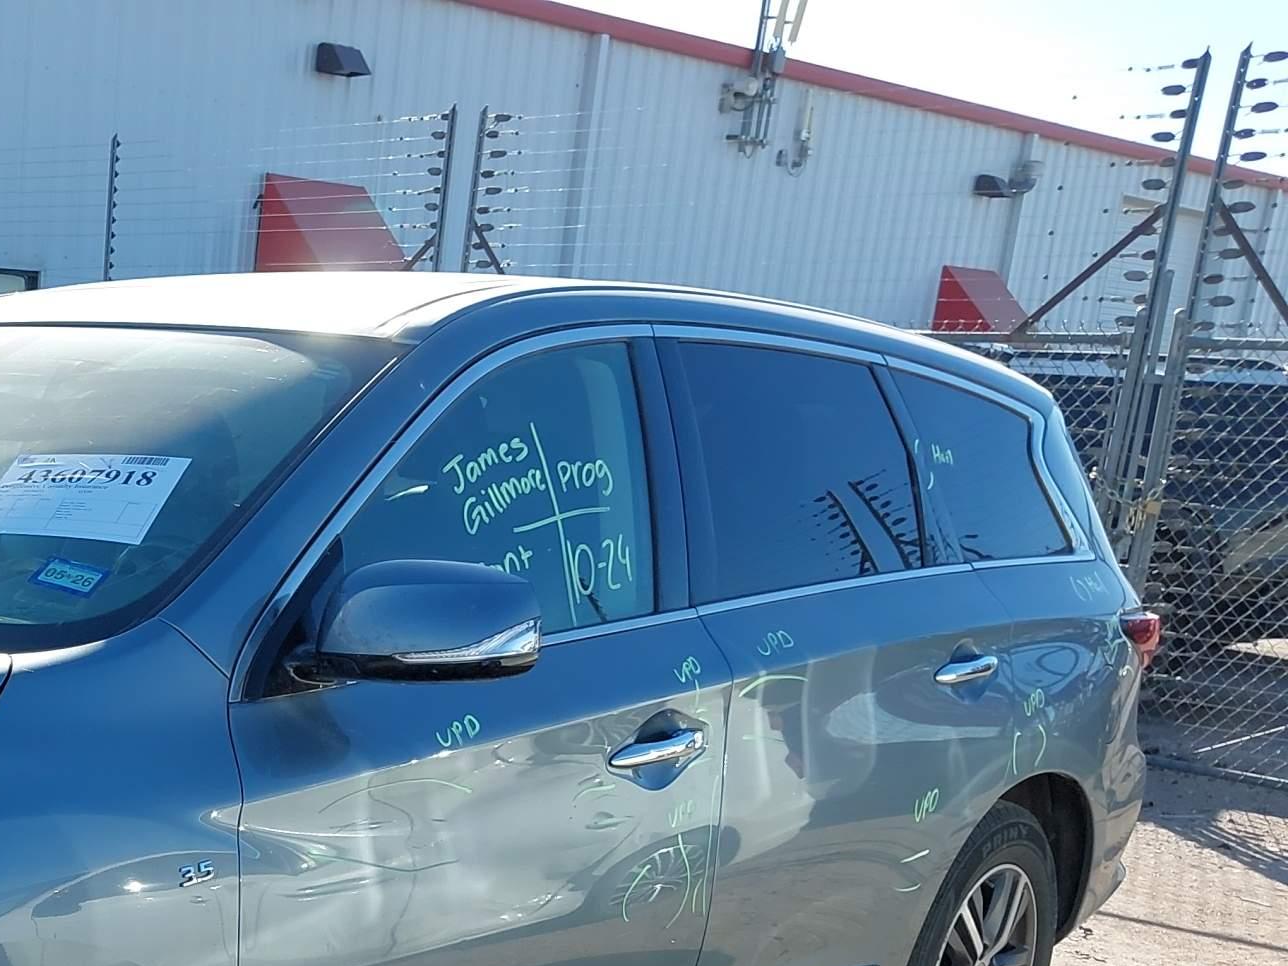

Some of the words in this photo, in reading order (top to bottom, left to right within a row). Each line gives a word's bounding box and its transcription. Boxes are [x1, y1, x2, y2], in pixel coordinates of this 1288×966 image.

[16, 468, 158, 487] 43607918
[442, 437, 529, 494] James
[463, 468, 547, 535] Gillmore
[44, 566, 65, 580] 05
[71, 574, 94, 588] 26
[566, 533, 632, 605] 10-24
[756, 630, 796, 658] UPD
[436, 714, 481, 748] UPD
